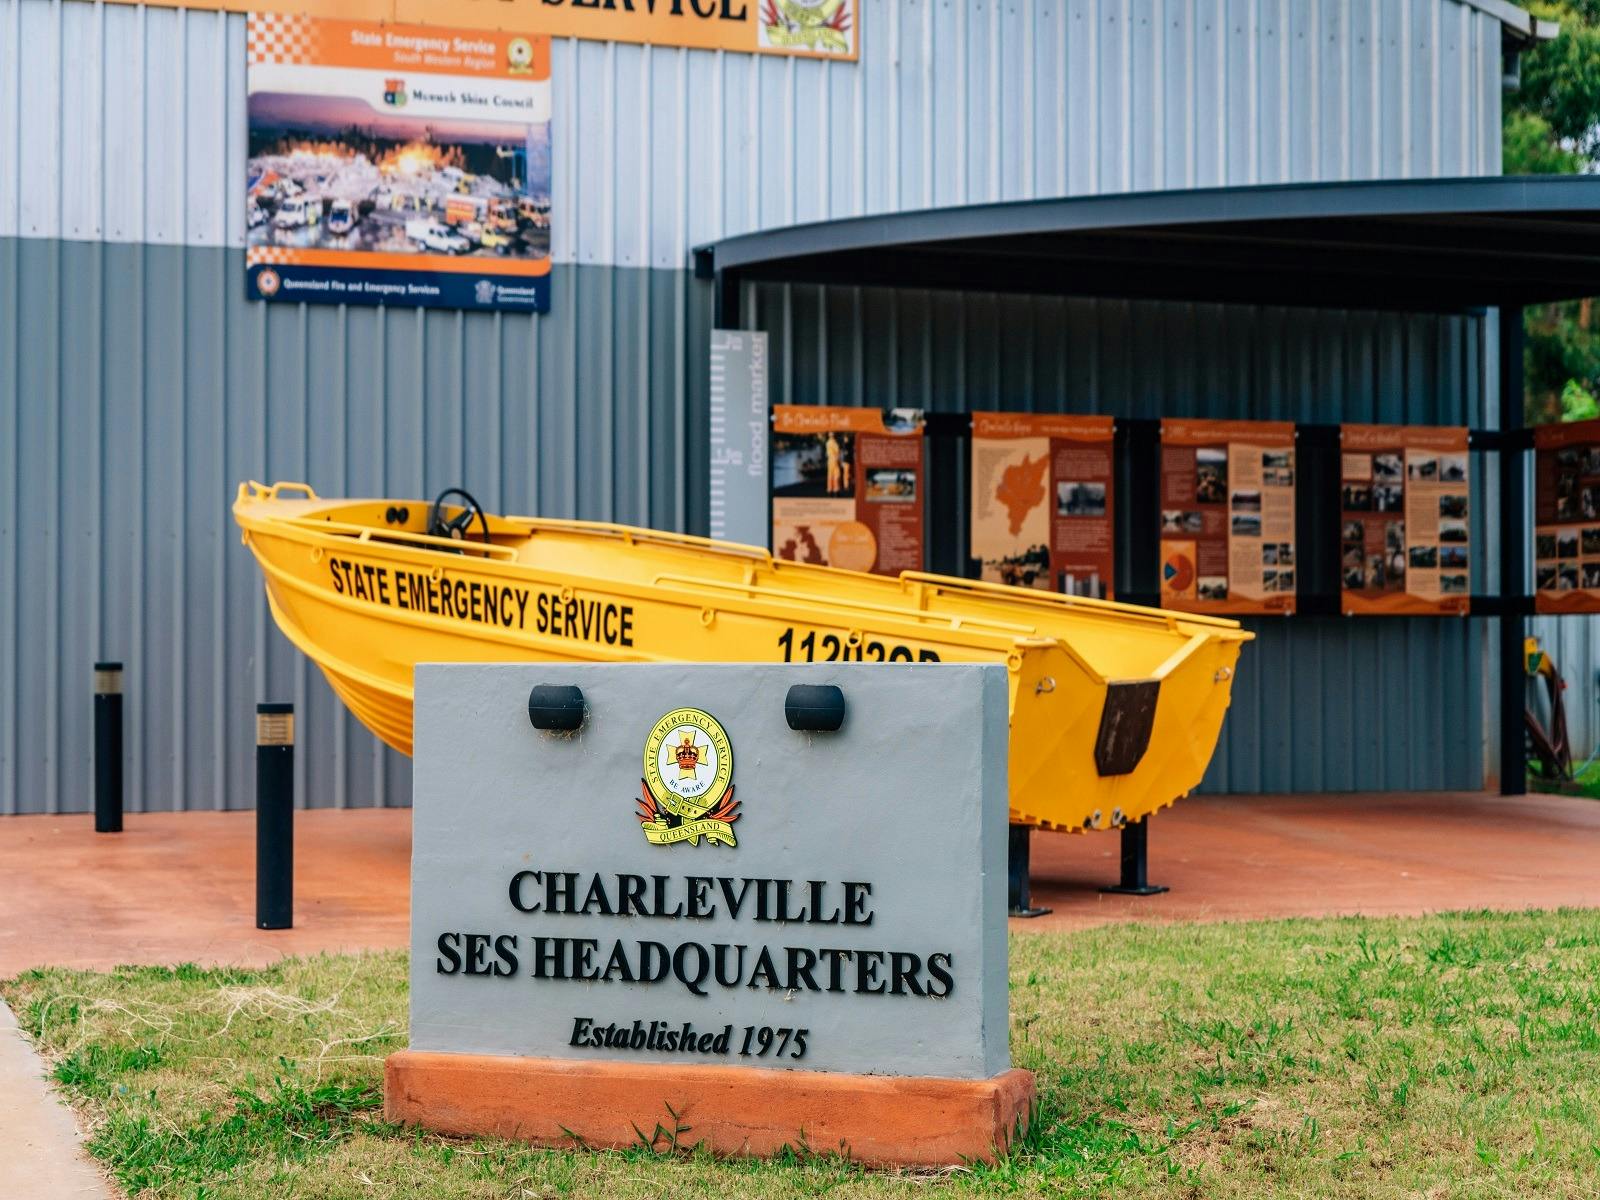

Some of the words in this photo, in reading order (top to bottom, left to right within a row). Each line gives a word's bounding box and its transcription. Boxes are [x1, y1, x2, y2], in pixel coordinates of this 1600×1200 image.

[352, 30, 382, 46] State
[385, 32, 449, 53] Emergency
[453, 37, 496, 55] Service
[329, 558, 390, 606] STATE
[394, 570, 529, 629] EMERGENCY
[537, 592, 634, 647] SERVICE
[648, 746, 659, 784] STATE
[654, 714, 713, 742] EMERGENCY
[713, 731, 728, 784] SERVICE
[681, 780, 705, 793] AWARE
[659, 822, 720, 842] QUEENSLAND
[508, 870, 876, 926] CHARLEVILLE
[436, 932, 518, 977] SES
[532, 935, 955, 998] HEADQUARTERS
[568, 1017, 733, 1055] Established
[738, 1025, 810, 1059] 1975
